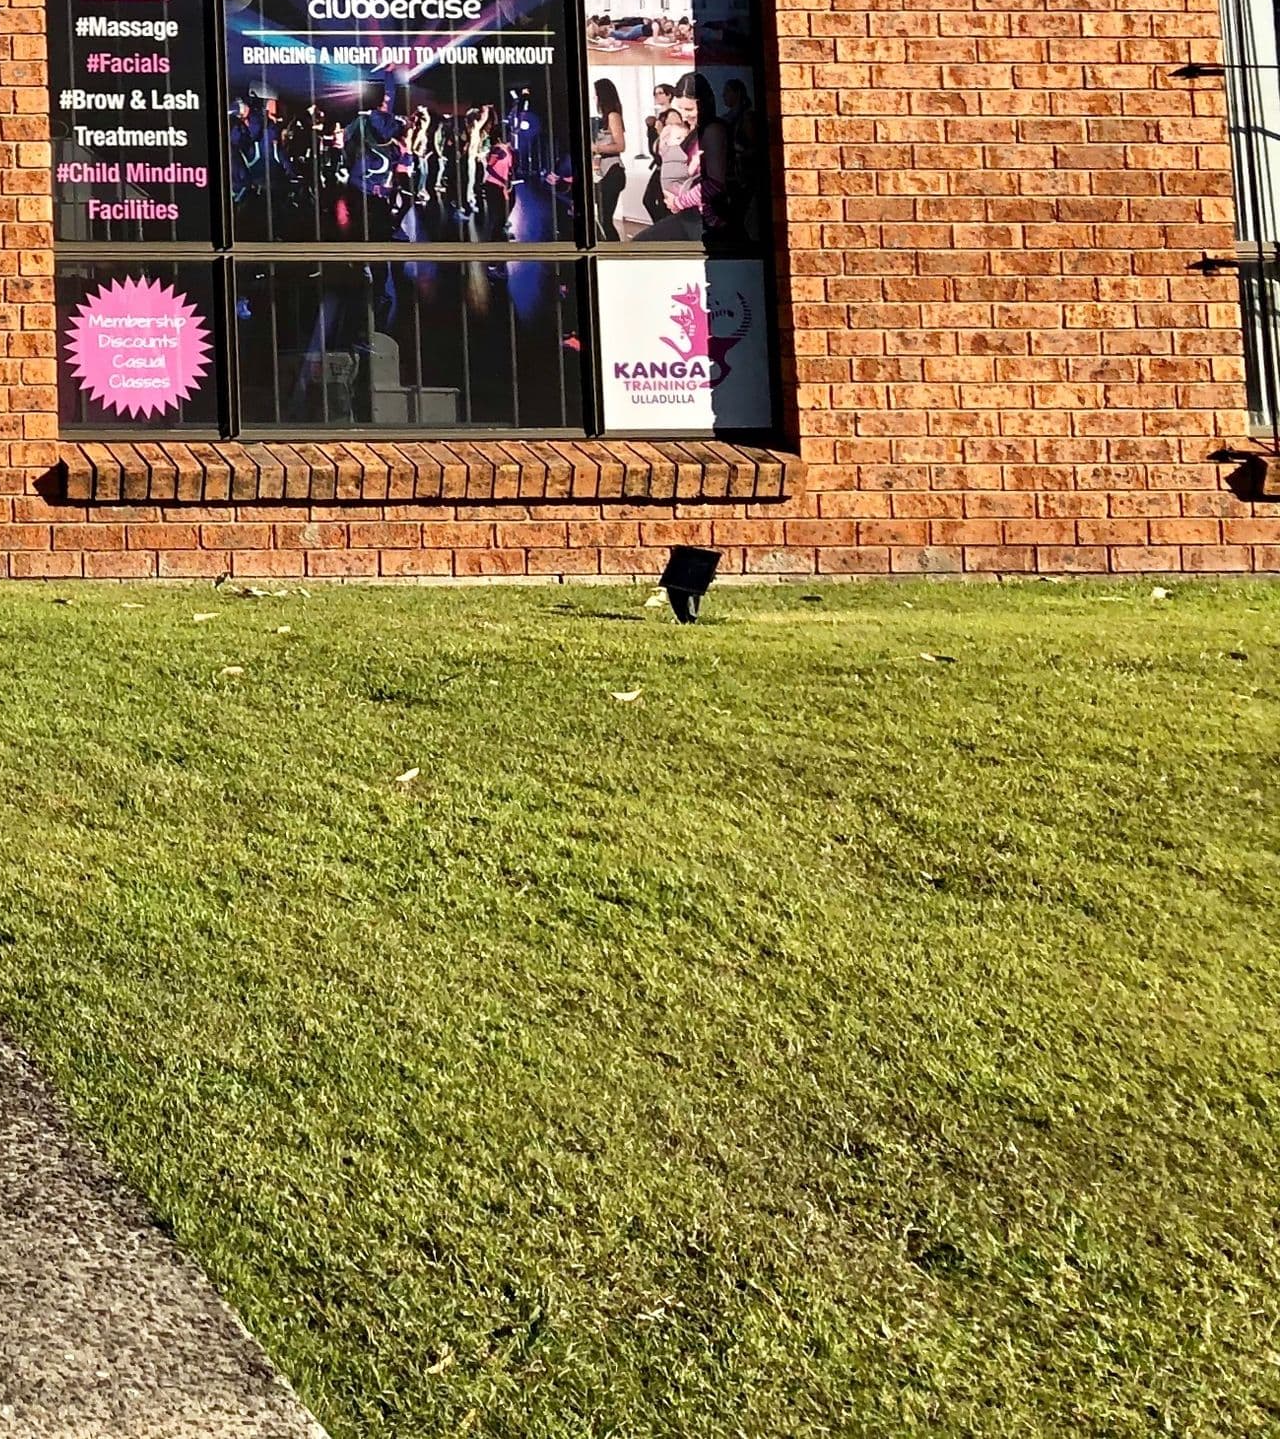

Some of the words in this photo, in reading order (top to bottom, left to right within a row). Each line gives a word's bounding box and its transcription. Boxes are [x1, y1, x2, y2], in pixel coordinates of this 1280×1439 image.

[75, 16, 179, 41] #Massage
[86, 52, 171, 73] #Facials
[243, 46, 317, 64] BRINGING
[319, 46, 330, 64] A
[333, 46, 378, 64] NIGHT
[381, 46, 413, 64] OUT
[415, 46, 435, 64] TO
[437, 46, 478, 64] YOUR
[481, 46, 555, 64] WORKOUT
[59, 89, 125, 110] #Brow
[130, 89, 147, 110] &
[151, 89, 200, 110] Lash
[73, 125, 188, 147] Treatments
[56, 162, 120, 183] #Child
[126, 162, 208, 188] Minding
[88, 198, 179, 220] Facilities
[87, 313, 187, 334] Membership
[97, 333, 178, 348] Discounts
[111, 353, 166, 369] Casual
[614, 361, 707, 379] KANGA
[108, 372, 171, 389] Classes
[623, 380, 698, 392] TRAINING
[631, 394, 695, 405] ULLADULLA
